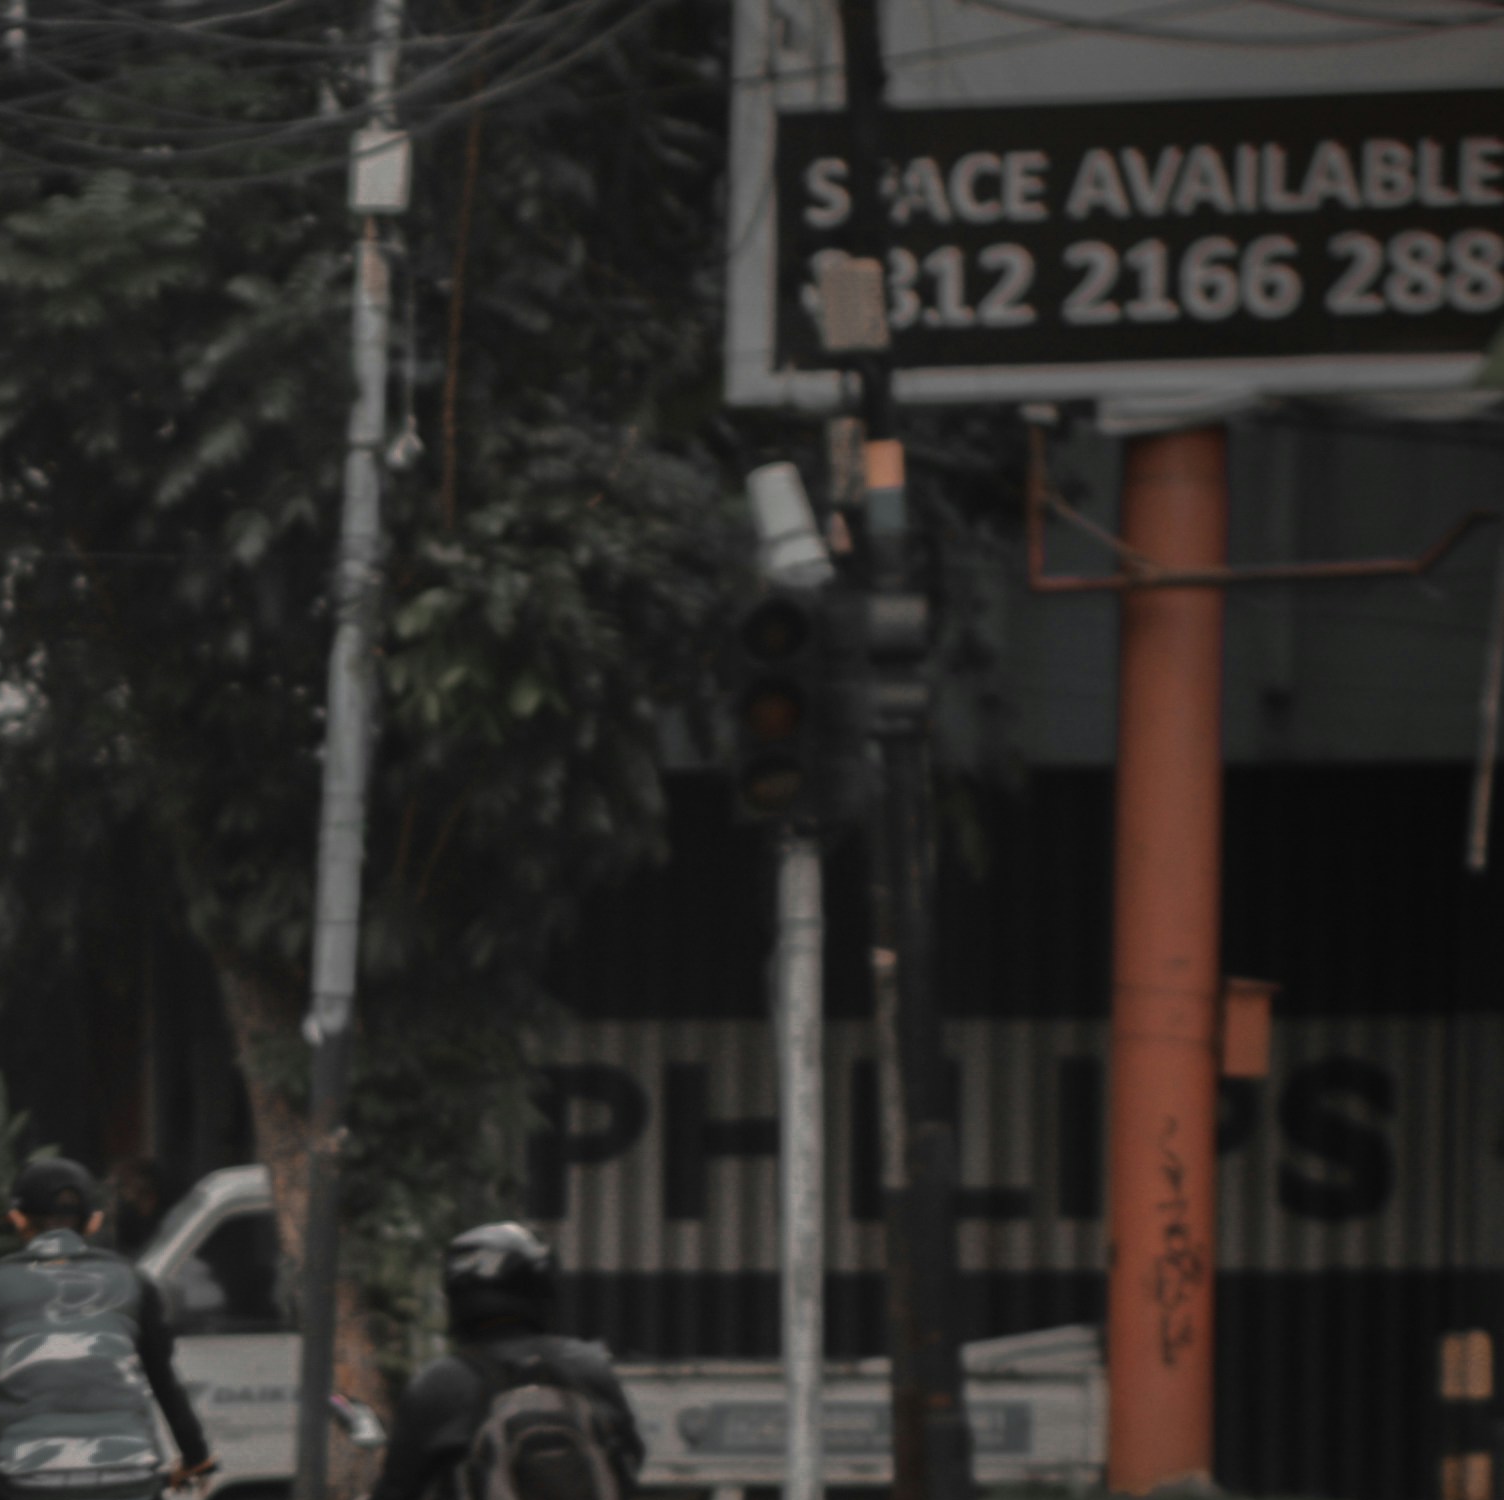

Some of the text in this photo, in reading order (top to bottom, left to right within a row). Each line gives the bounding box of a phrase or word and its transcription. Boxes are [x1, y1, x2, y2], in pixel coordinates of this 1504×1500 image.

[804, 135, 1504, 228] SACE AVAILABLE
[801, 243, 1037, 329] 12
[1062, 235, 1303, 325] 2166
